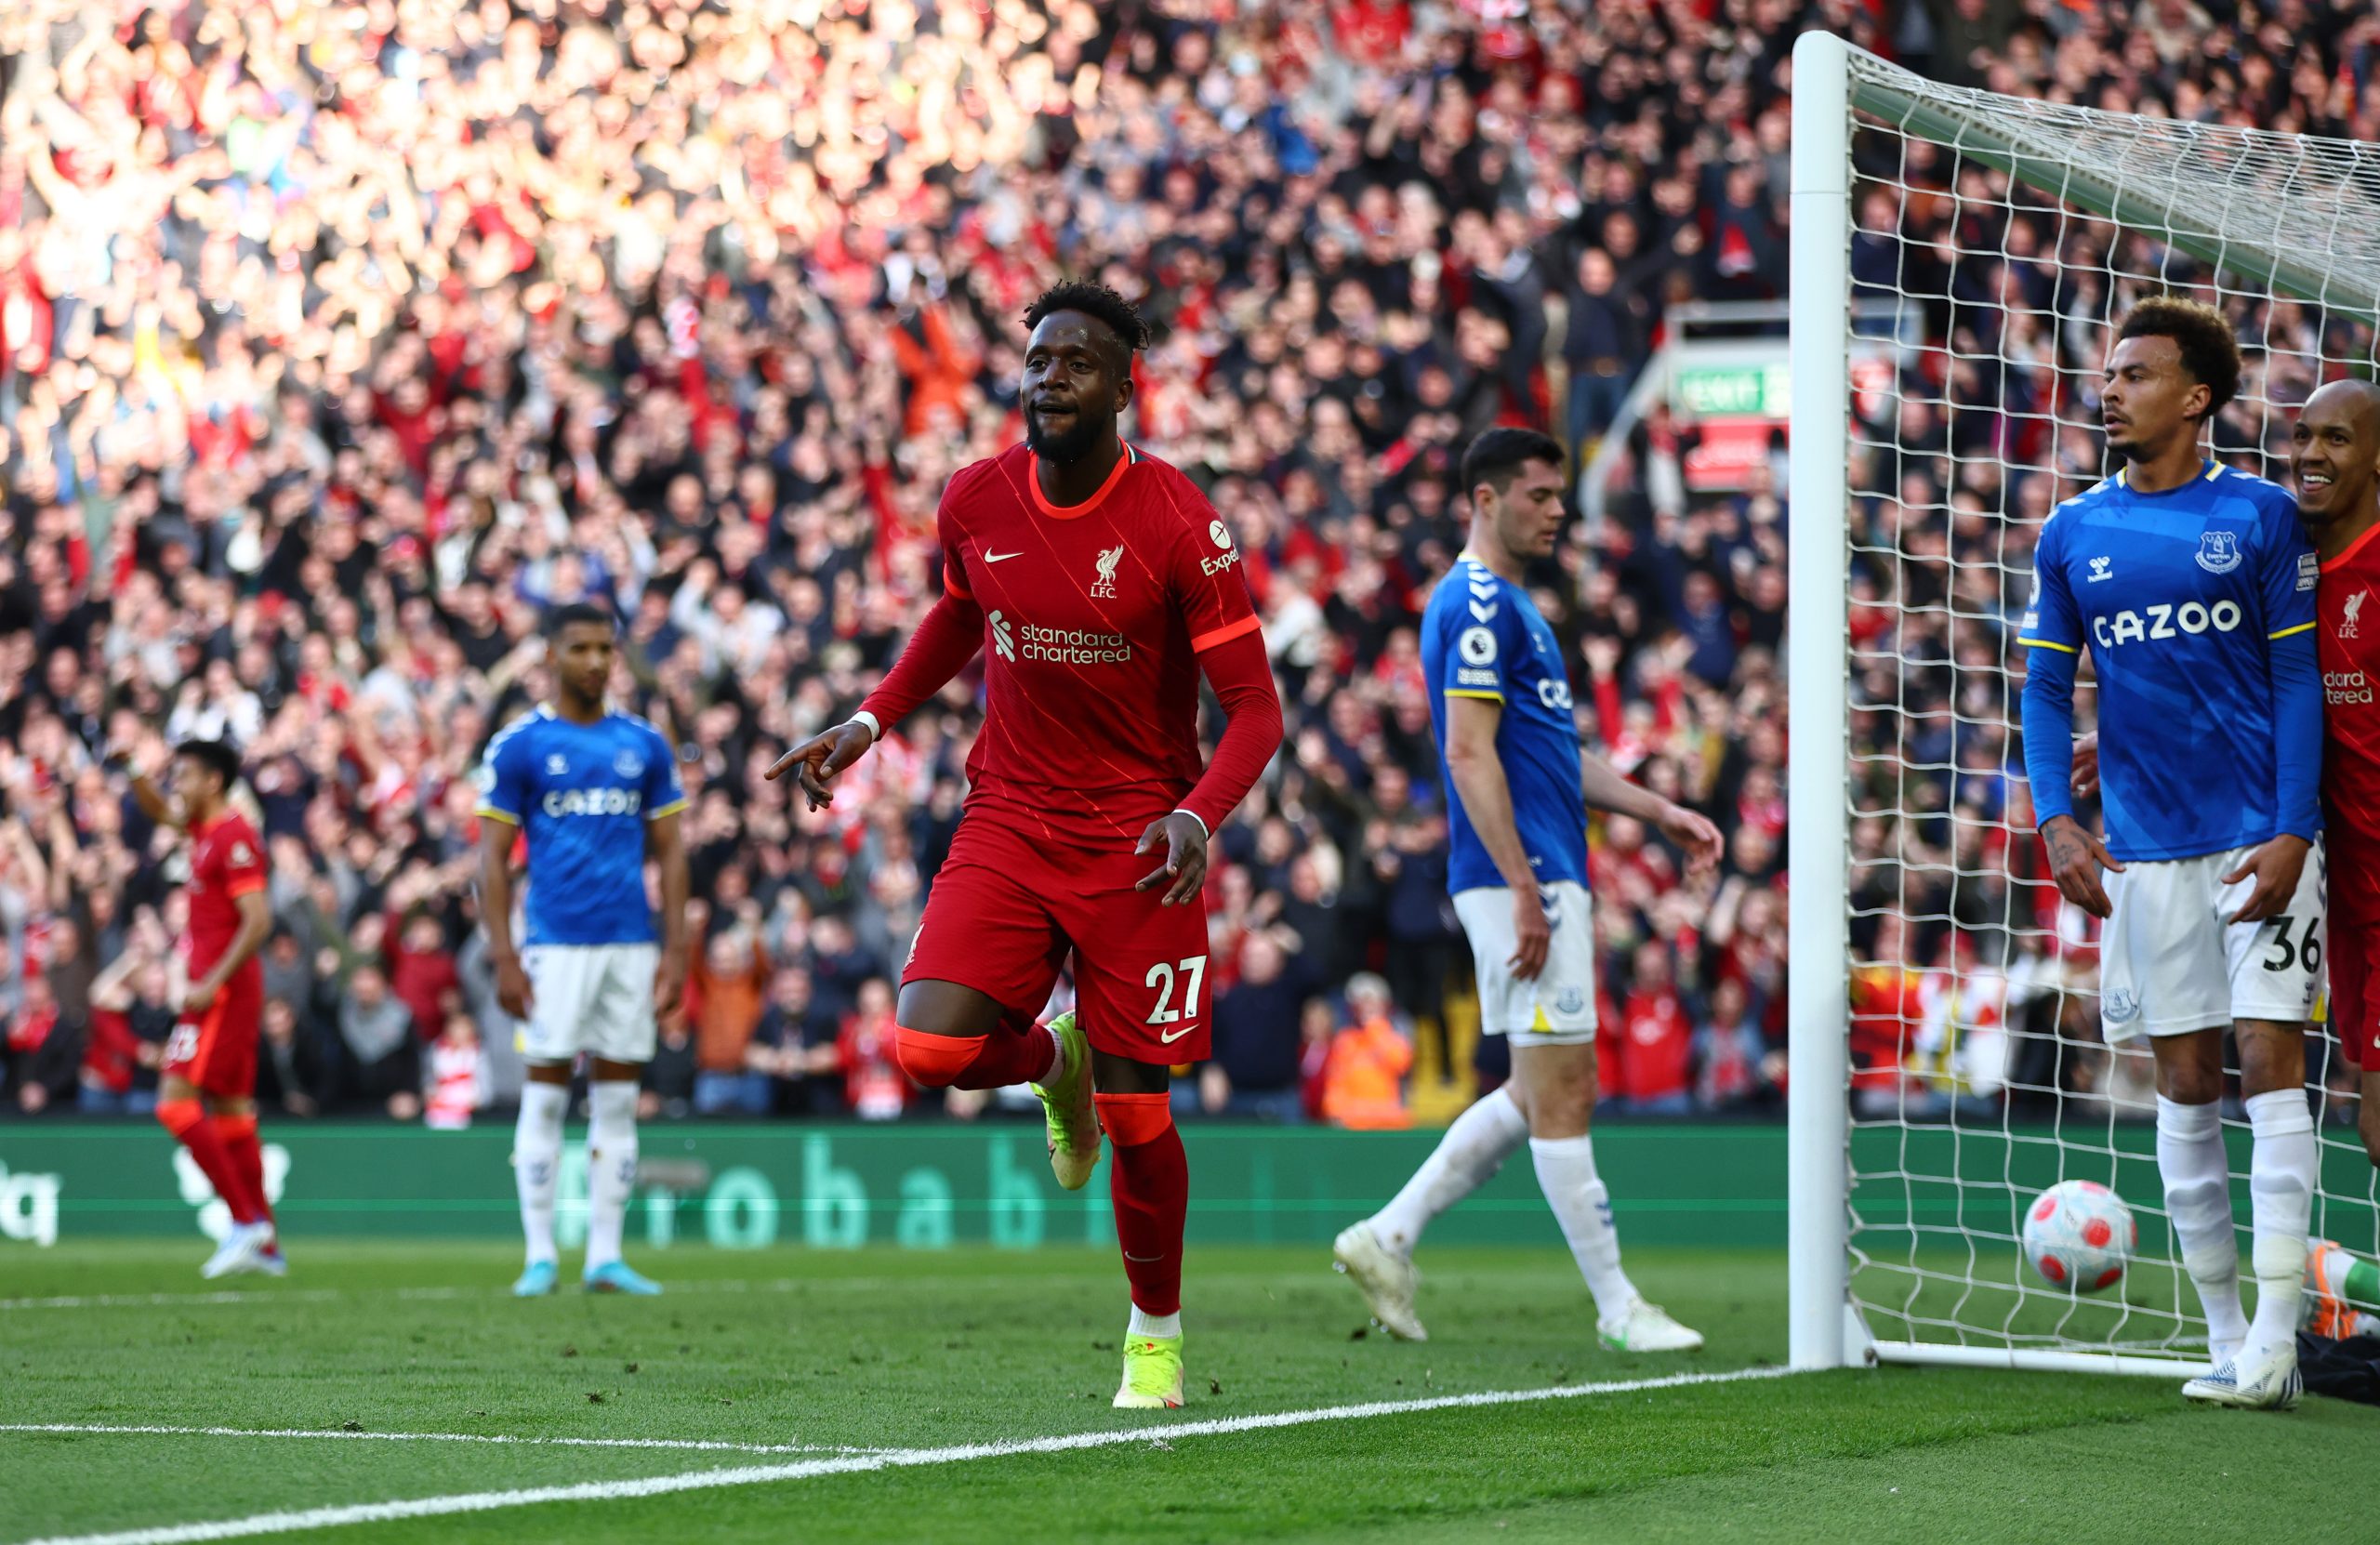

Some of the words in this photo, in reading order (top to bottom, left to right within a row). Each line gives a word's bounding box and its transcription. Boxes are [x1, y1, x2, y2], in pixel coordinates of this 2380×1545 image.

[1090, 586, 1117, 599] L.F.C.
[1021, 624, 1124, 646] standard
[2093, 600, 2241, 649] CAZOO
[1022, 642, 1131, 664] chartered
[2263, 916, 2322, 974] 36
[1145, 955, 1208, 1023] 27
